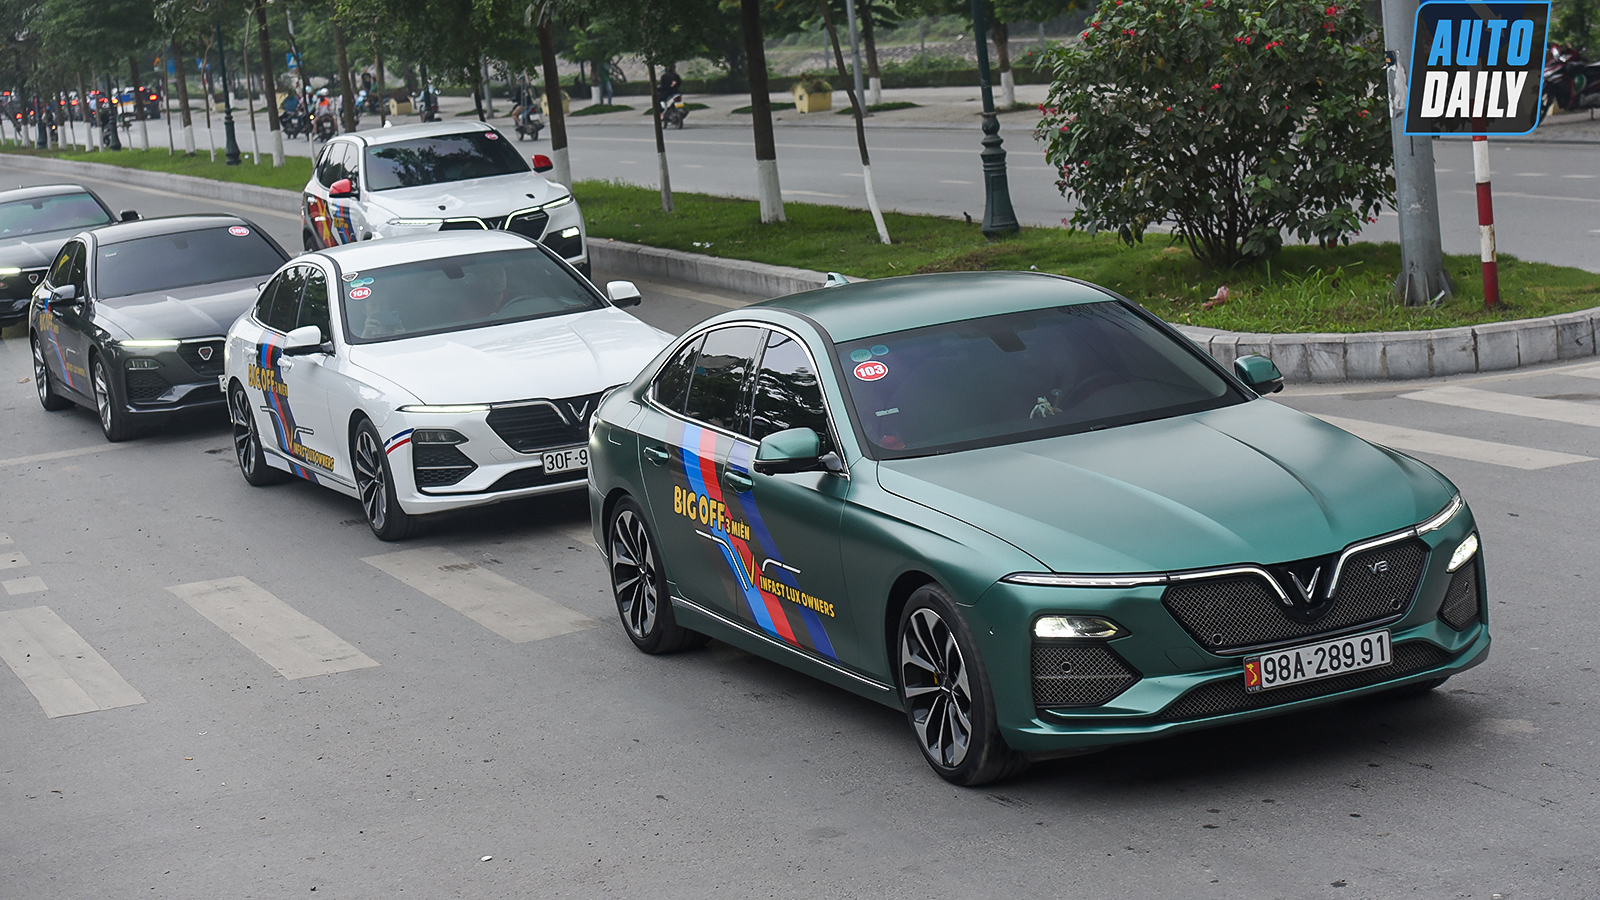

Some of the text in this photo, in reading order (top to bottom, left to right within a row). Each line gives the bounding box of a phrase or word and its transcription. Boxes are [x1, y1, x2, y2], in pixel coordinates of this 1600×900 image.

[352, 289, 369, 297] 104
[248, 364, 261, 390] BIG
[261, 367, 275, 393] OFF
[857, 365, 885, 377] 103
[546, 449, 588, 471] 30F-9
[674, 485, 697, 521] BIG
[698, 495, 726, 531] OFF
[725, 518, 731, 534] 3
[786, 586, 801, 604] LUX
[801, 594, 836, 618] OWNERS
[1263, 634, 1386, 684] 98A-289.91
